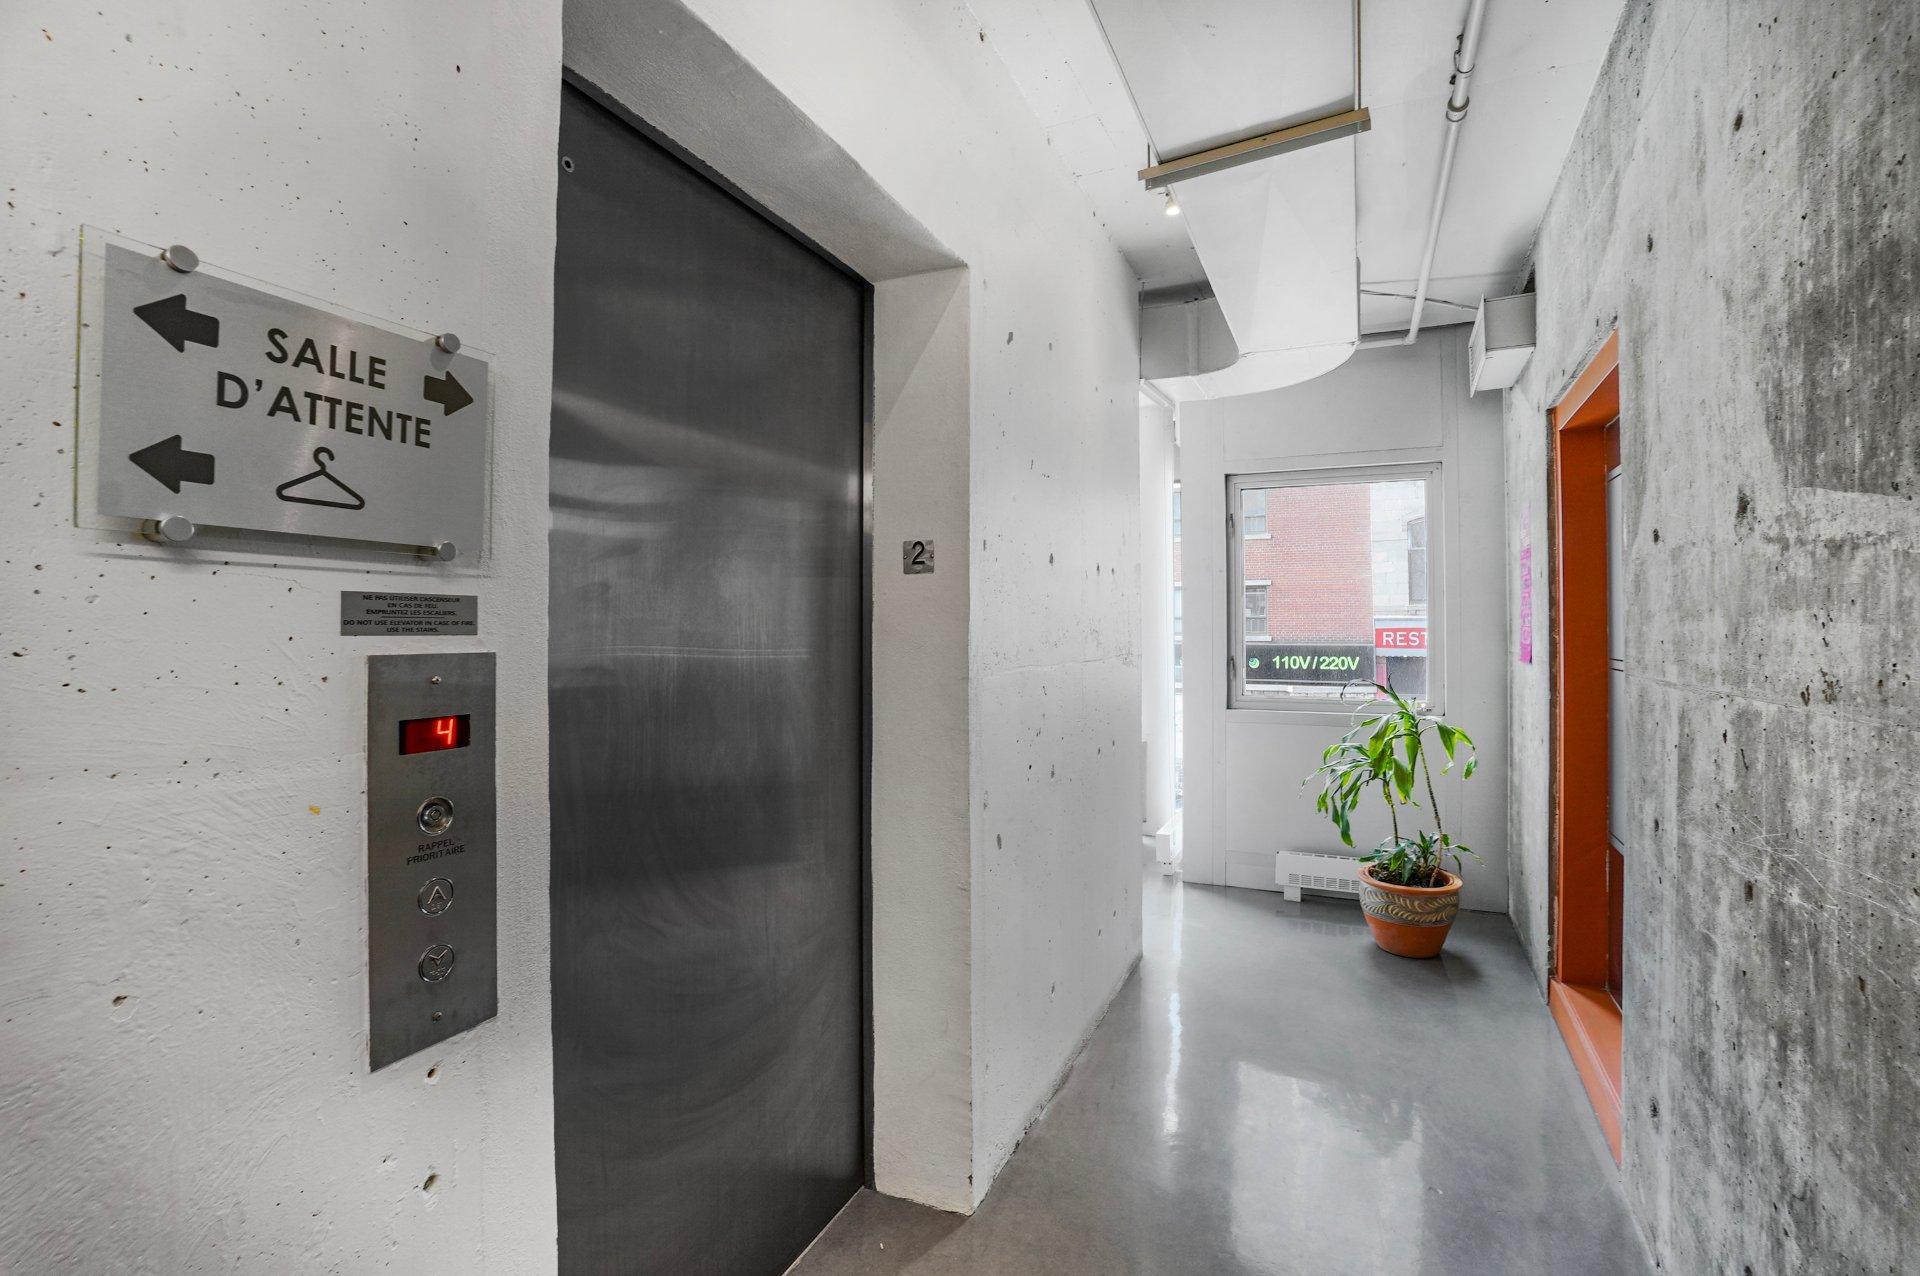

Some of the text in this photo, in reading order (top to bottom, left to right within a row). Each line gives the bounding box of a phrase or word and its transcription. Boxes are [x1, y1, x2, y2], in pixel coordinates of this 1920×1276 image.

[265, 328, 387, 390] SALLE
[216, 371, 431, 448] D'ATTENTE
[911, 540, 926, 565] 2
[436, 718, 455, 745] 4
[406, 844, 466, 866] PRIORITAIRE
[417, 838, 454, 853] RAPPEL
